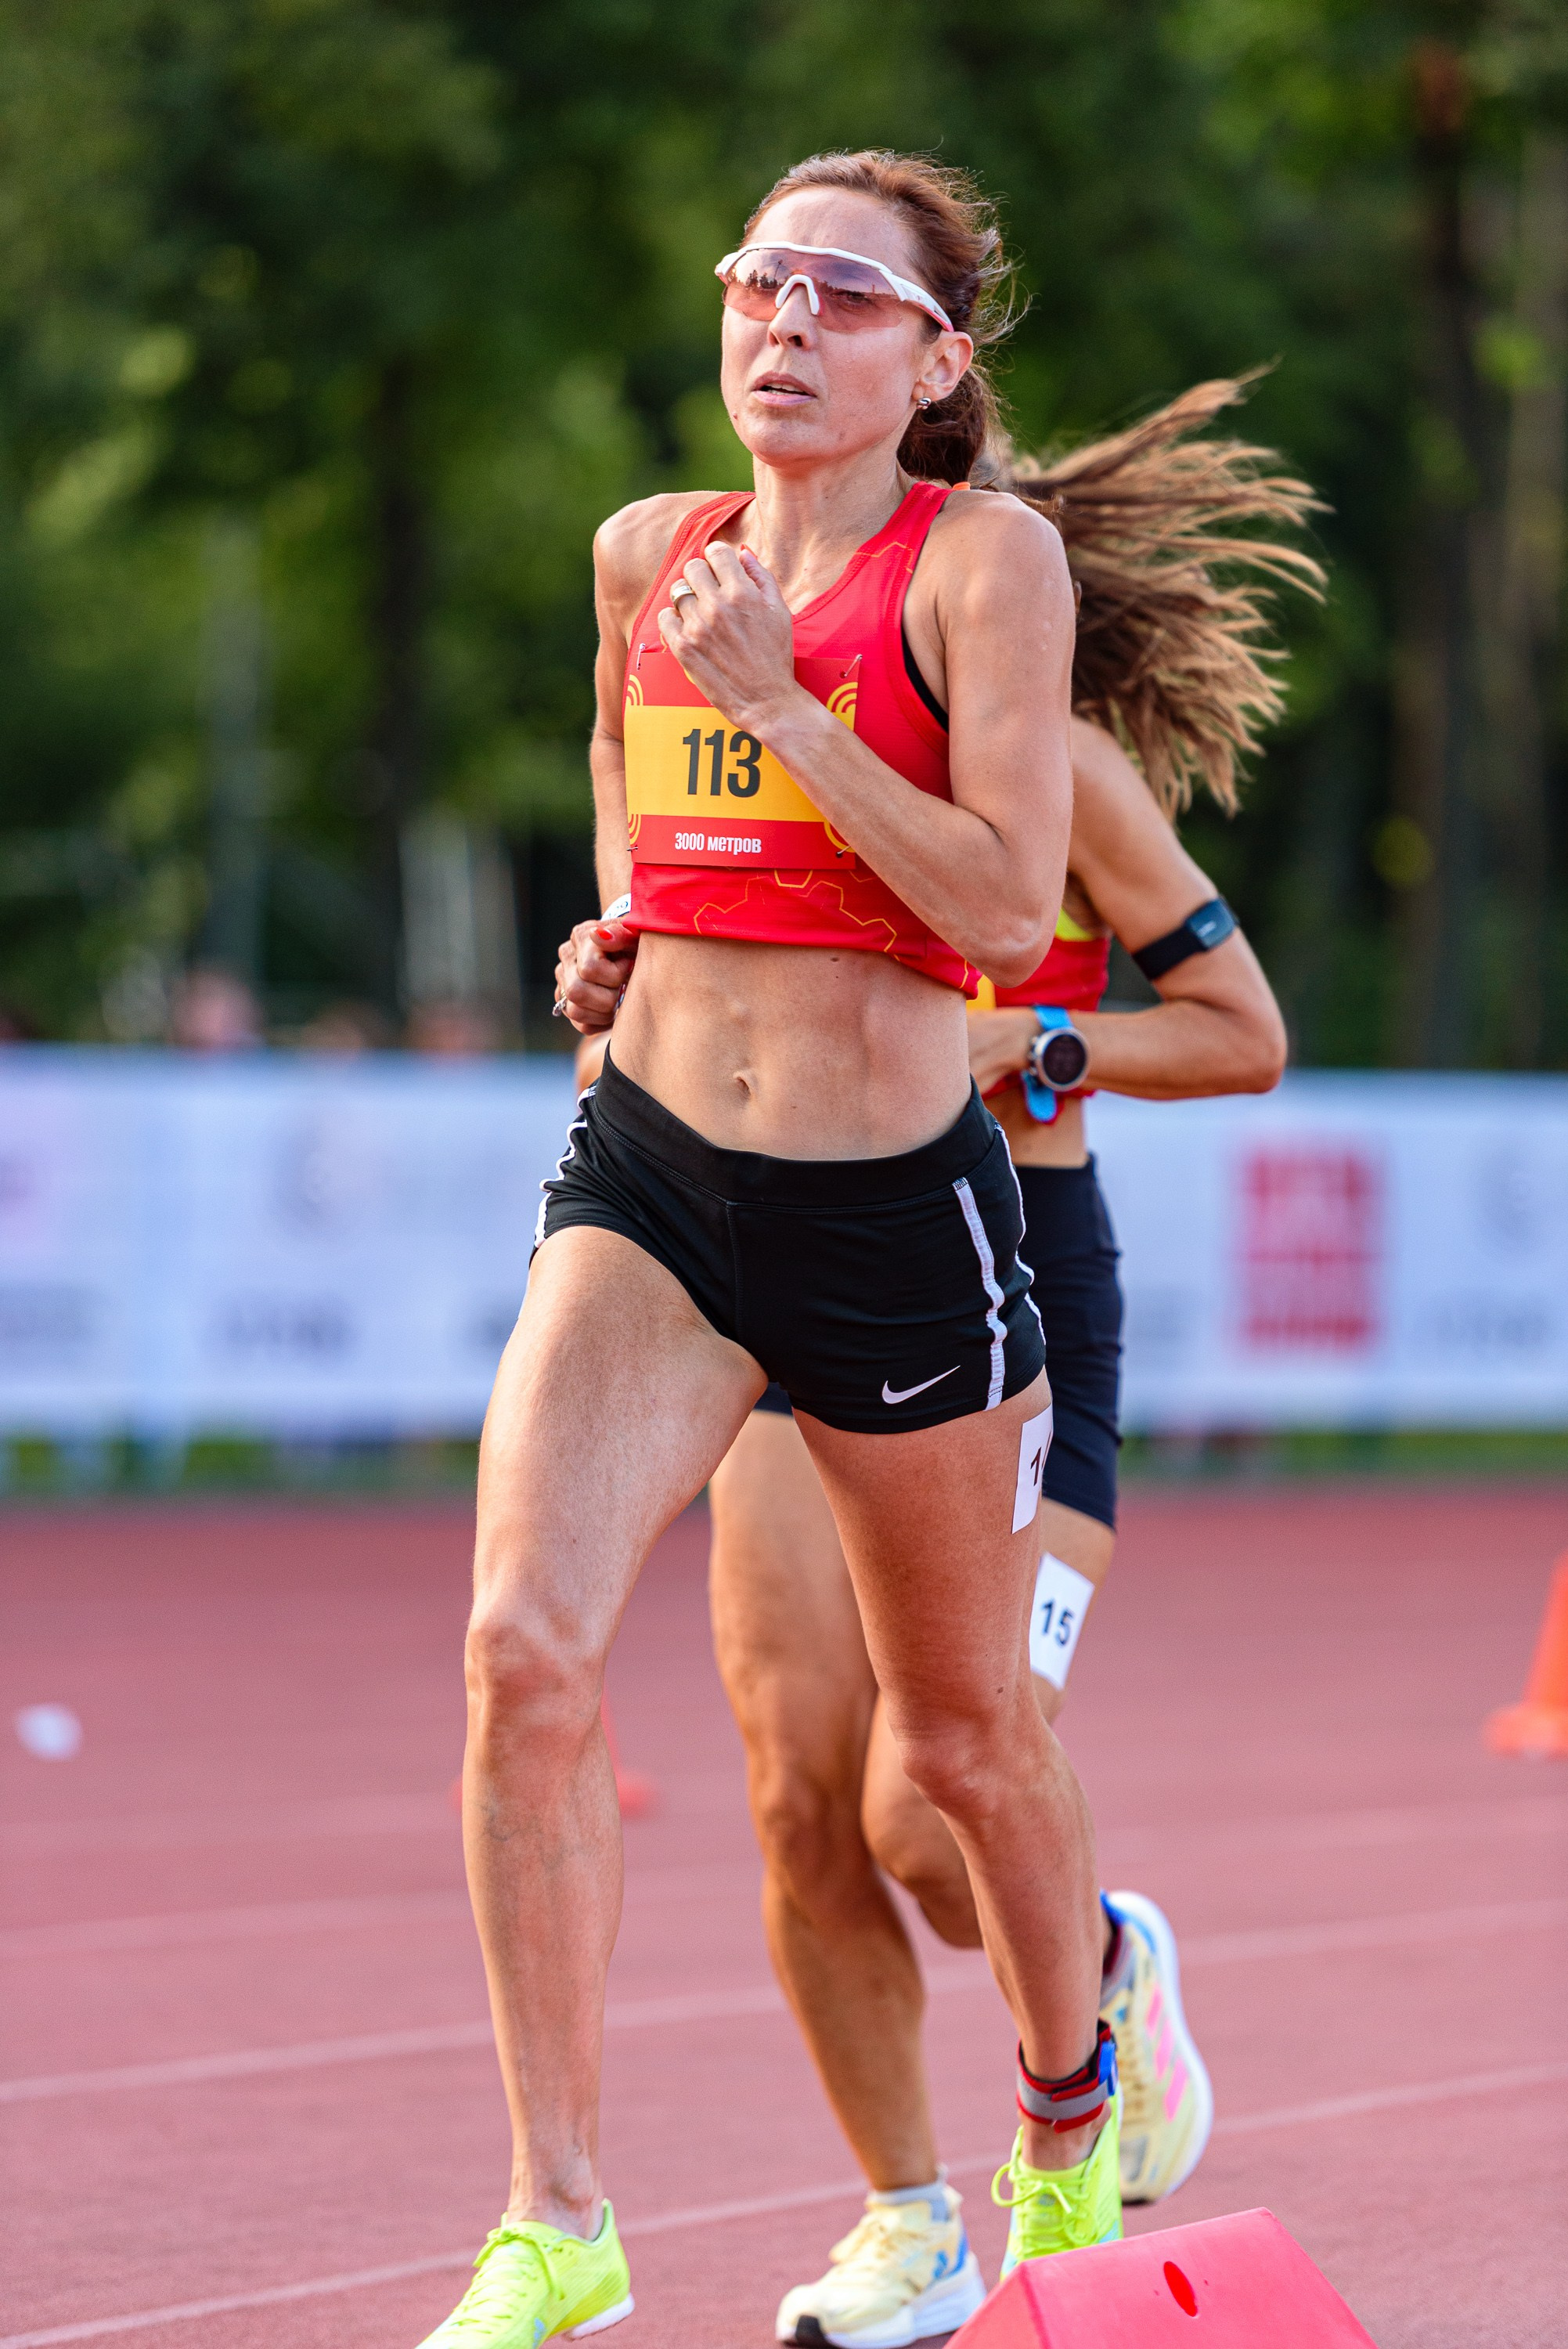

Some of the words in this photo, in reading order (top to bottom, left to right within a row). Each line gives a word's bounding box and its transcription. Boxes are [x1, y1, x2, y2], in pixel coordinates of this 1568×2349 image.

[683, 728, 762, 798] 113
[674, 832, 705, 851] 3000
[707, 835, 762, 856] метров
[1040, 1599, 1075, 1647] 15
